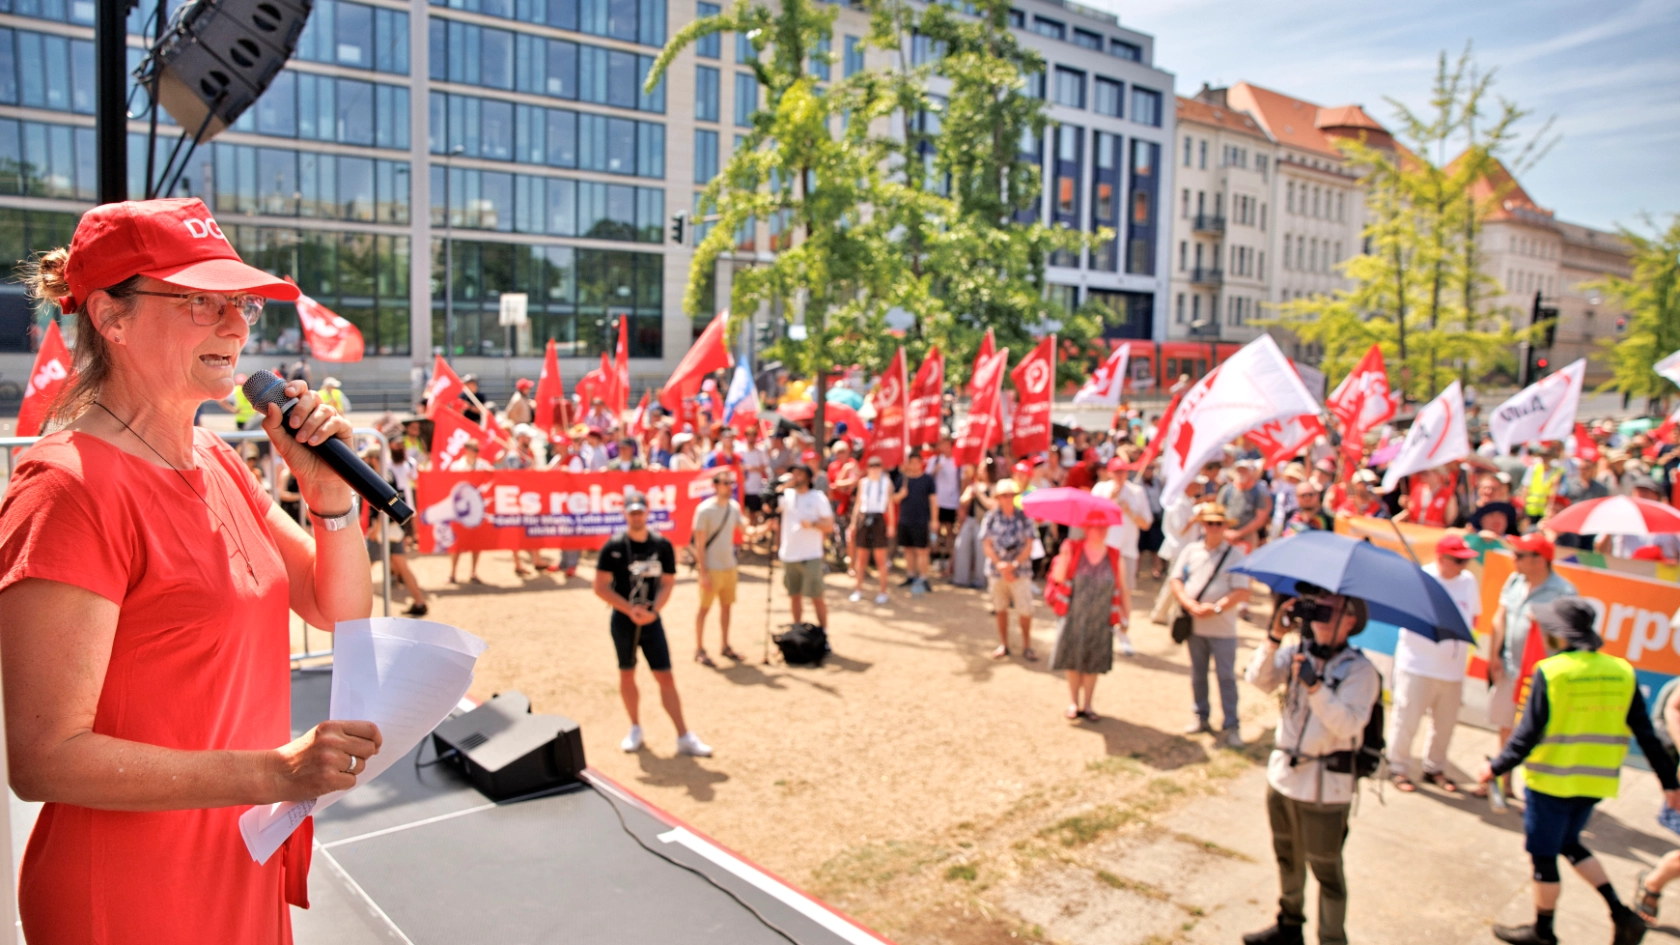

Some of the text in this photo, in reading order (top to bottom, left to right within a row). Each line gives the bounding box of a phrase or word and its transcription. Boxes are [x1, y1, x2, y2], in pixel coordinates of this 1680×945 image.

[494, 484, 677, 515] Es reict!
[1583, 596, 1680, 662] rp
